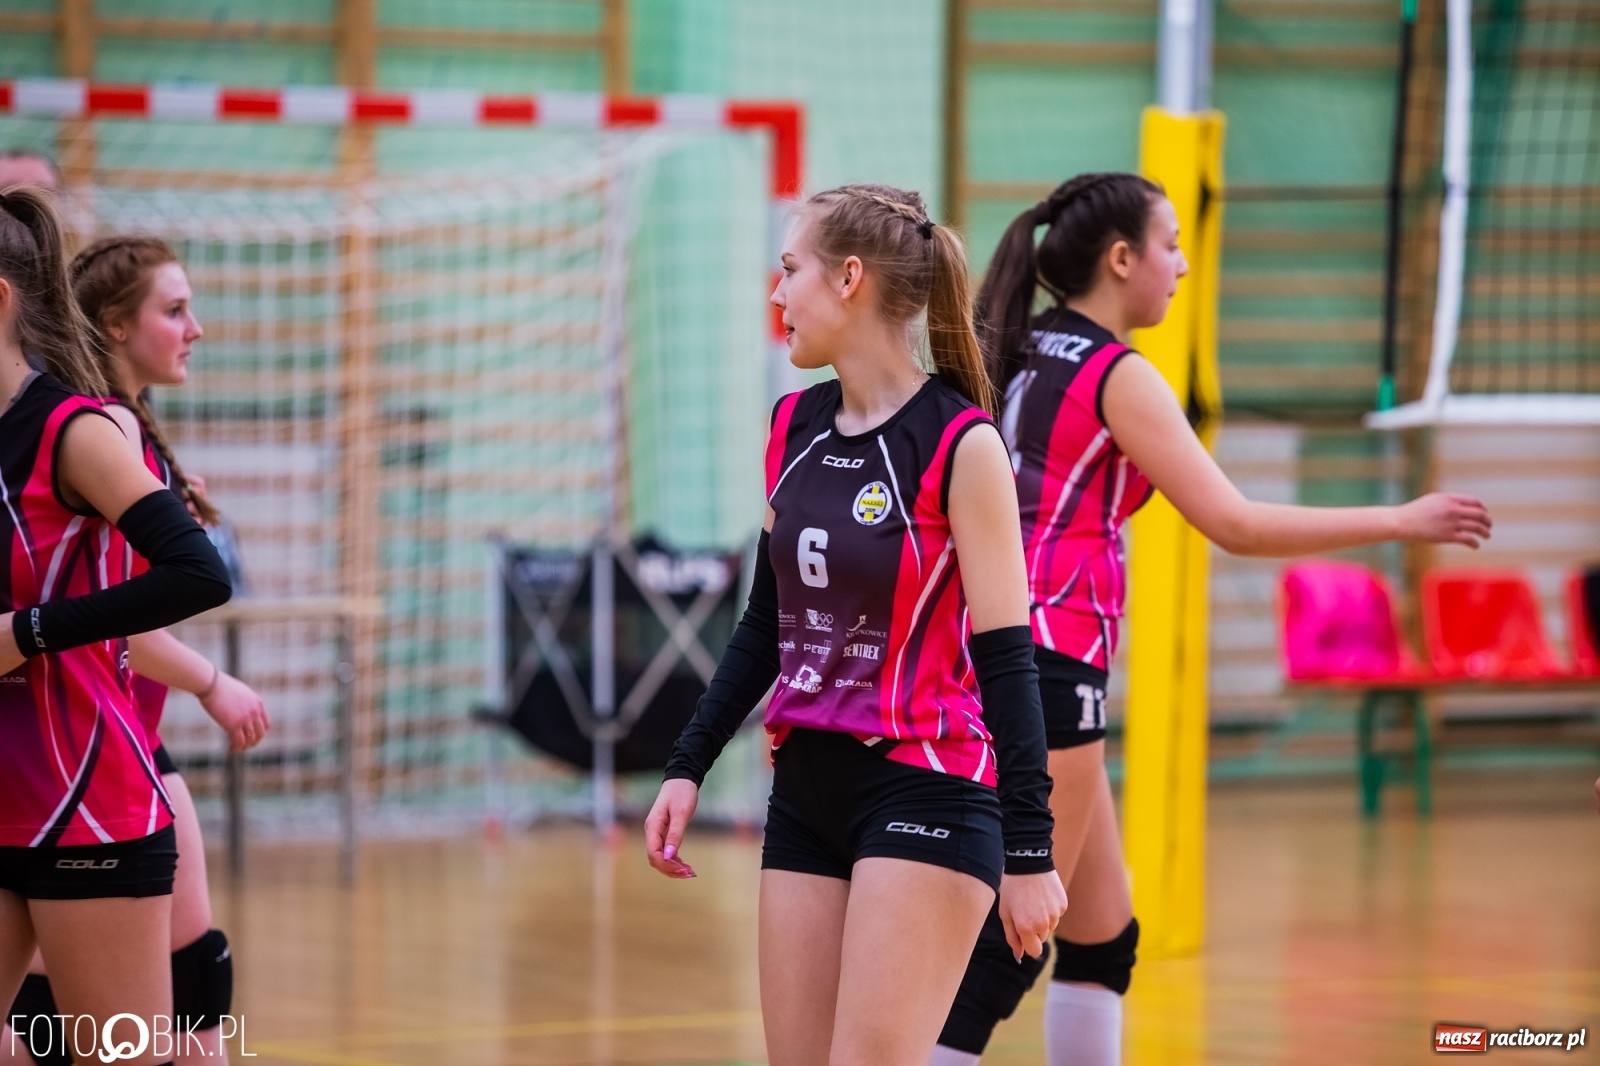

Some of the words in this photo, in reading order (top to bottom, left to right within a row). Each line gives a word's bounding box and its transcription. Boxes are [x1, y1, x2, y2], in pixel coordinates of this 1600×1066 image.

[821, 454, 865, 469] COLO
[797, 526, 829, 589] 6
[30, 607, 47, 648] COLO
[842, 643, 880, 660] SENTREX
[885, 821, 951, 839] COLO
[55, 859, 120, 869] COLO
